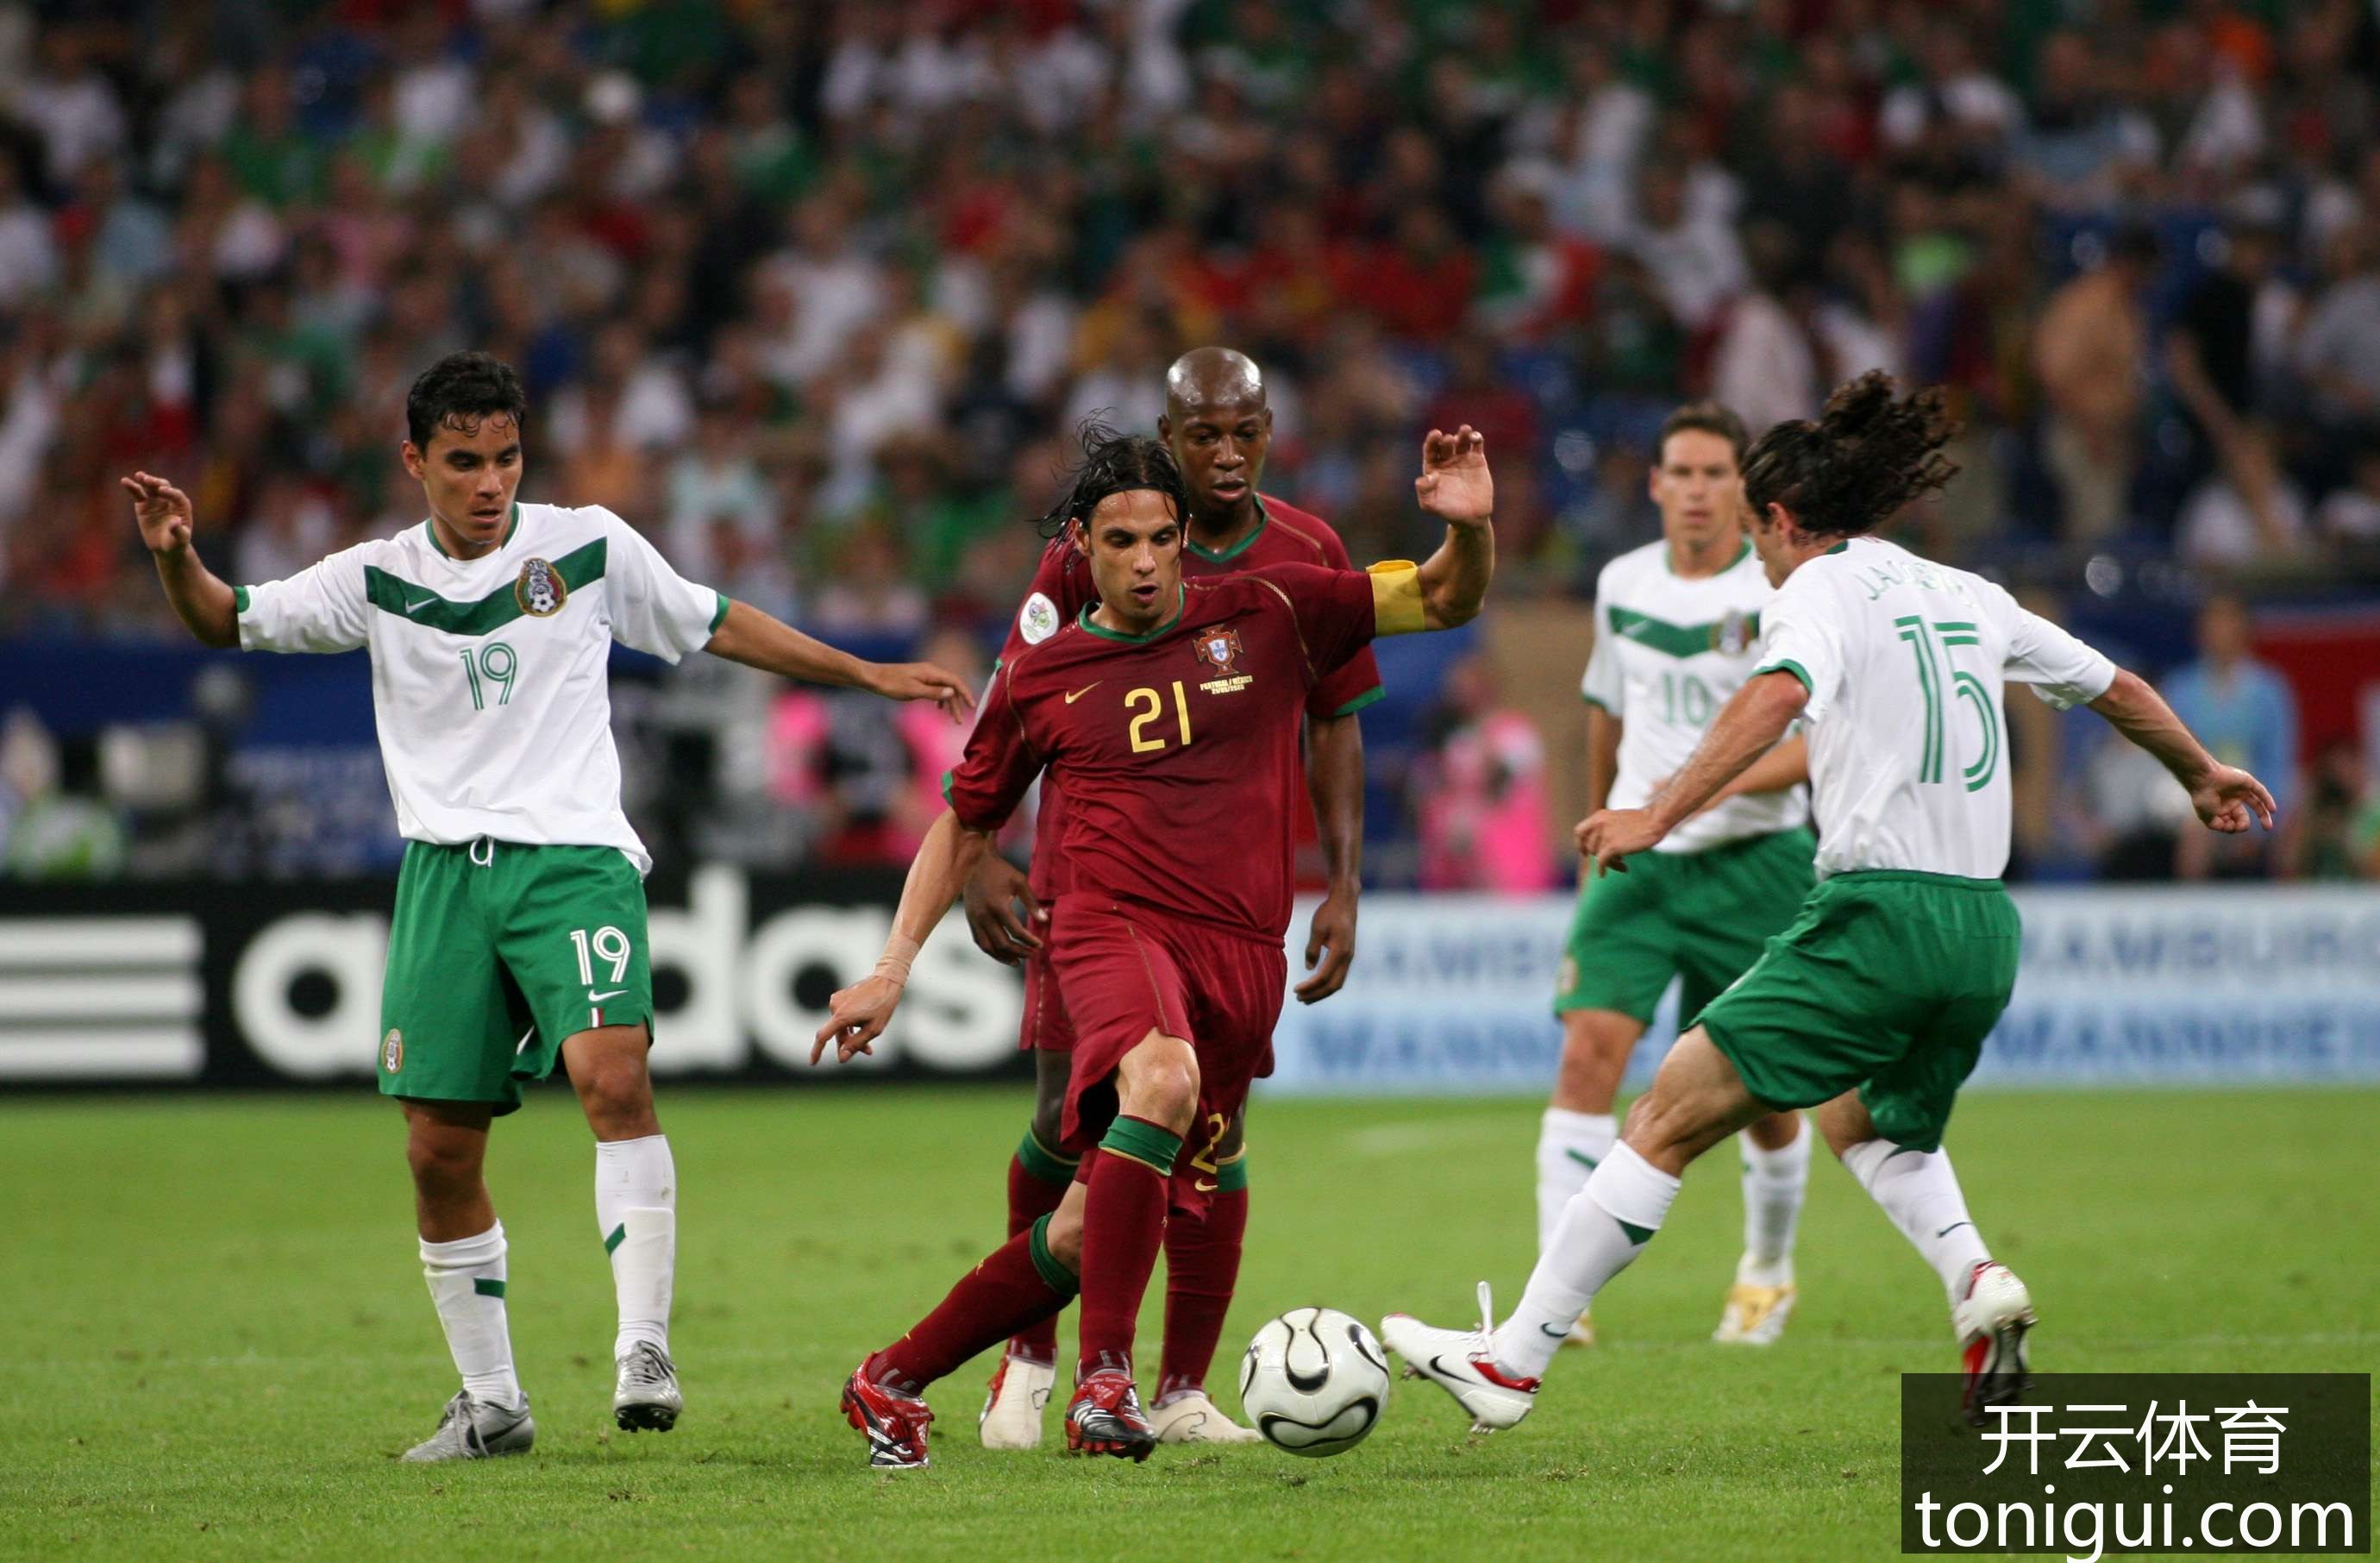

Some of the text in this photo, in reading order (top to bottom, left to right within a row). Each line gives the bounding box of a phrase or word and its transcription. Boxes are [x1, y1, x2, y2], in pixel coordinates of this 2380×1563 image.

[460, 642, 517, 710] 19
[1659, 670, 1712, 727] 10
[1895, 615, 1998, 792] 15
[1124, 681, 1192, 753] 21
[231, 864, 1024, 1077] adas
[570, 926, 630, 985] 19
